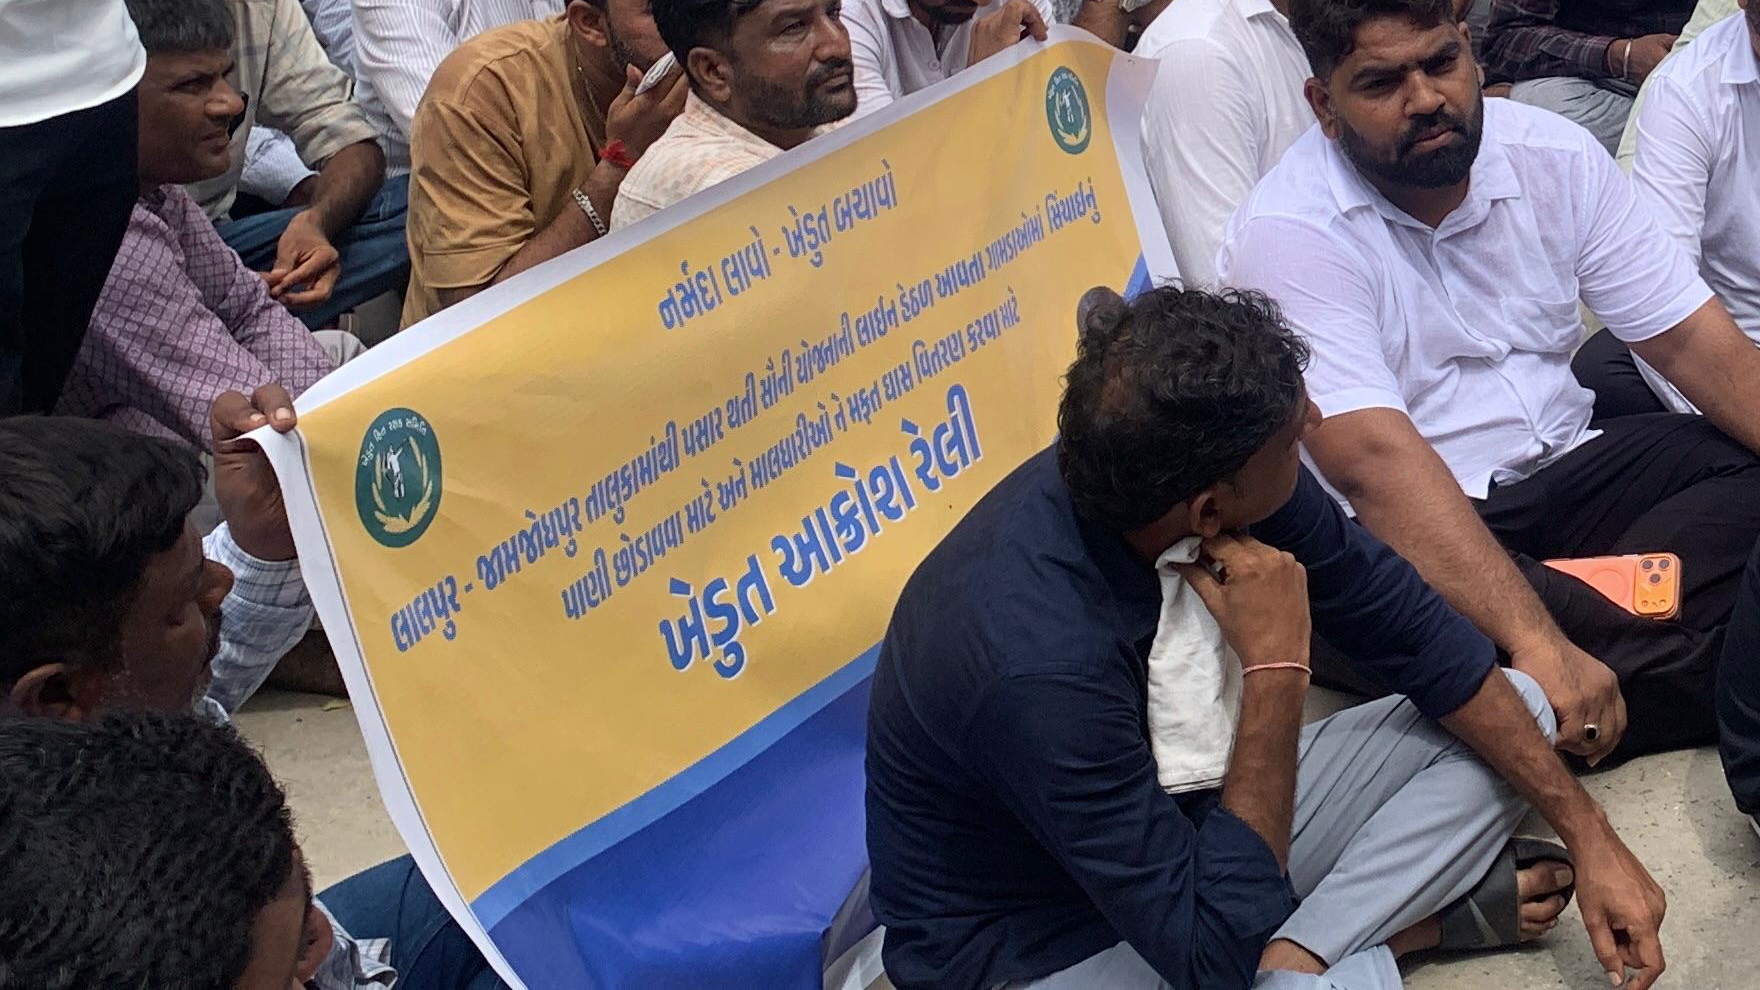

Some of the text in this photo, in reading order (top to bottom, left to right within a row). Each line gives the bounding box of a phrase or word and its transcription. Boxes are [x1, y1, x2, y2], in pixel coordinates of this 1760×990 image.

[658, 260, 723, 330] નર્મદા
[721, 226, 771, 296] લાવો
[781, 205, 832, 267] ખેડુત
[833, 159, 897, 232] બચાવો
[391, 575, 461, 652] લાલપુર
[477, 510, 582, 590] જામજોધપુર
[585, 421, 680, 525] તાલુકામાંથી
[682, 407, 724, 457] પસાર
[727, 372, 758, 428] થતી
[796, 311, 855, 384] યોજનાની
[897, 282, 934, 322] હેઠળ
[935, 251, 986, 298] આવતા
[985, 204, 1045, 271] ગામડાઓમાં
[561, 547, 612, 620] પાણી
[613, 511, 684, 587] છોડાવવા
[685, 478, 716, 534] માટે
[717, 458, 748, 510] અને
[749, 402, 833, 490] માલધારીઓ
[882, 362, 914, 401] ઘાસ
[912, 330, 966, 383] વિતરણ
[967, 309, 1001, 352] કરવા
[1000, 285, 1020, 329] માટે
[659, 383, 983, 680] ખેડુત આક્રોશ રેલી
